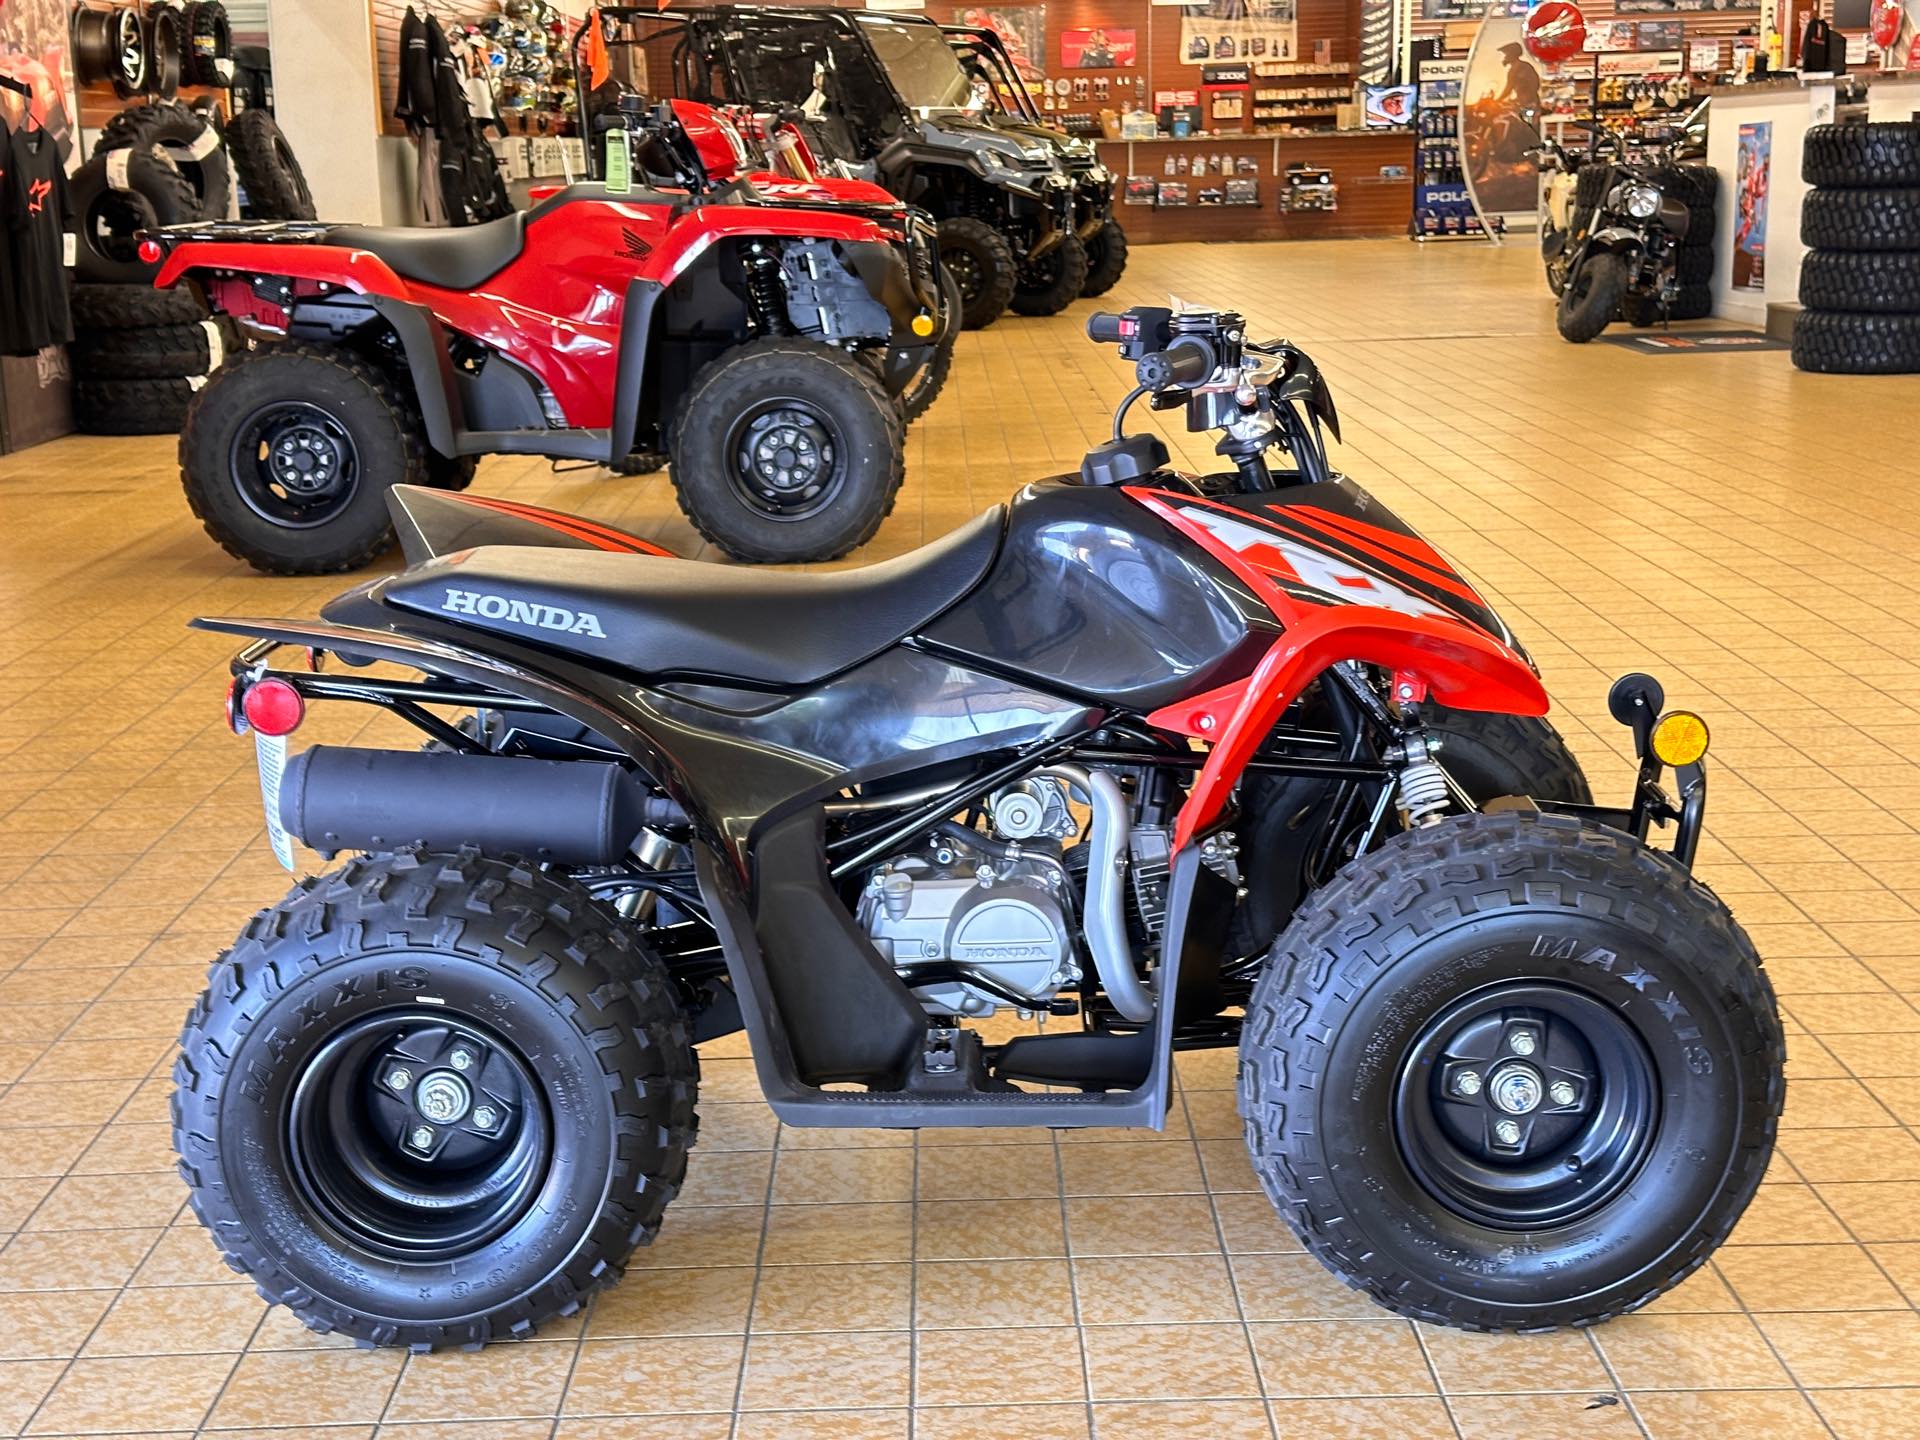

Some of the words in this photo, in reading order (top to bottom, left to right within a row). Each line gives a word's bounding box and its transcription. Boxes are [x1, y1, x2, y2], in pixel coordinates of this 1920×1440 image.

[441, 588, 607, 639] HONDA
[965, 946, 1048, 960] HONDA
[239, 965, 431, 1105] MAXXIS
[1529, 934, 1714, 1075] MAXXIS
